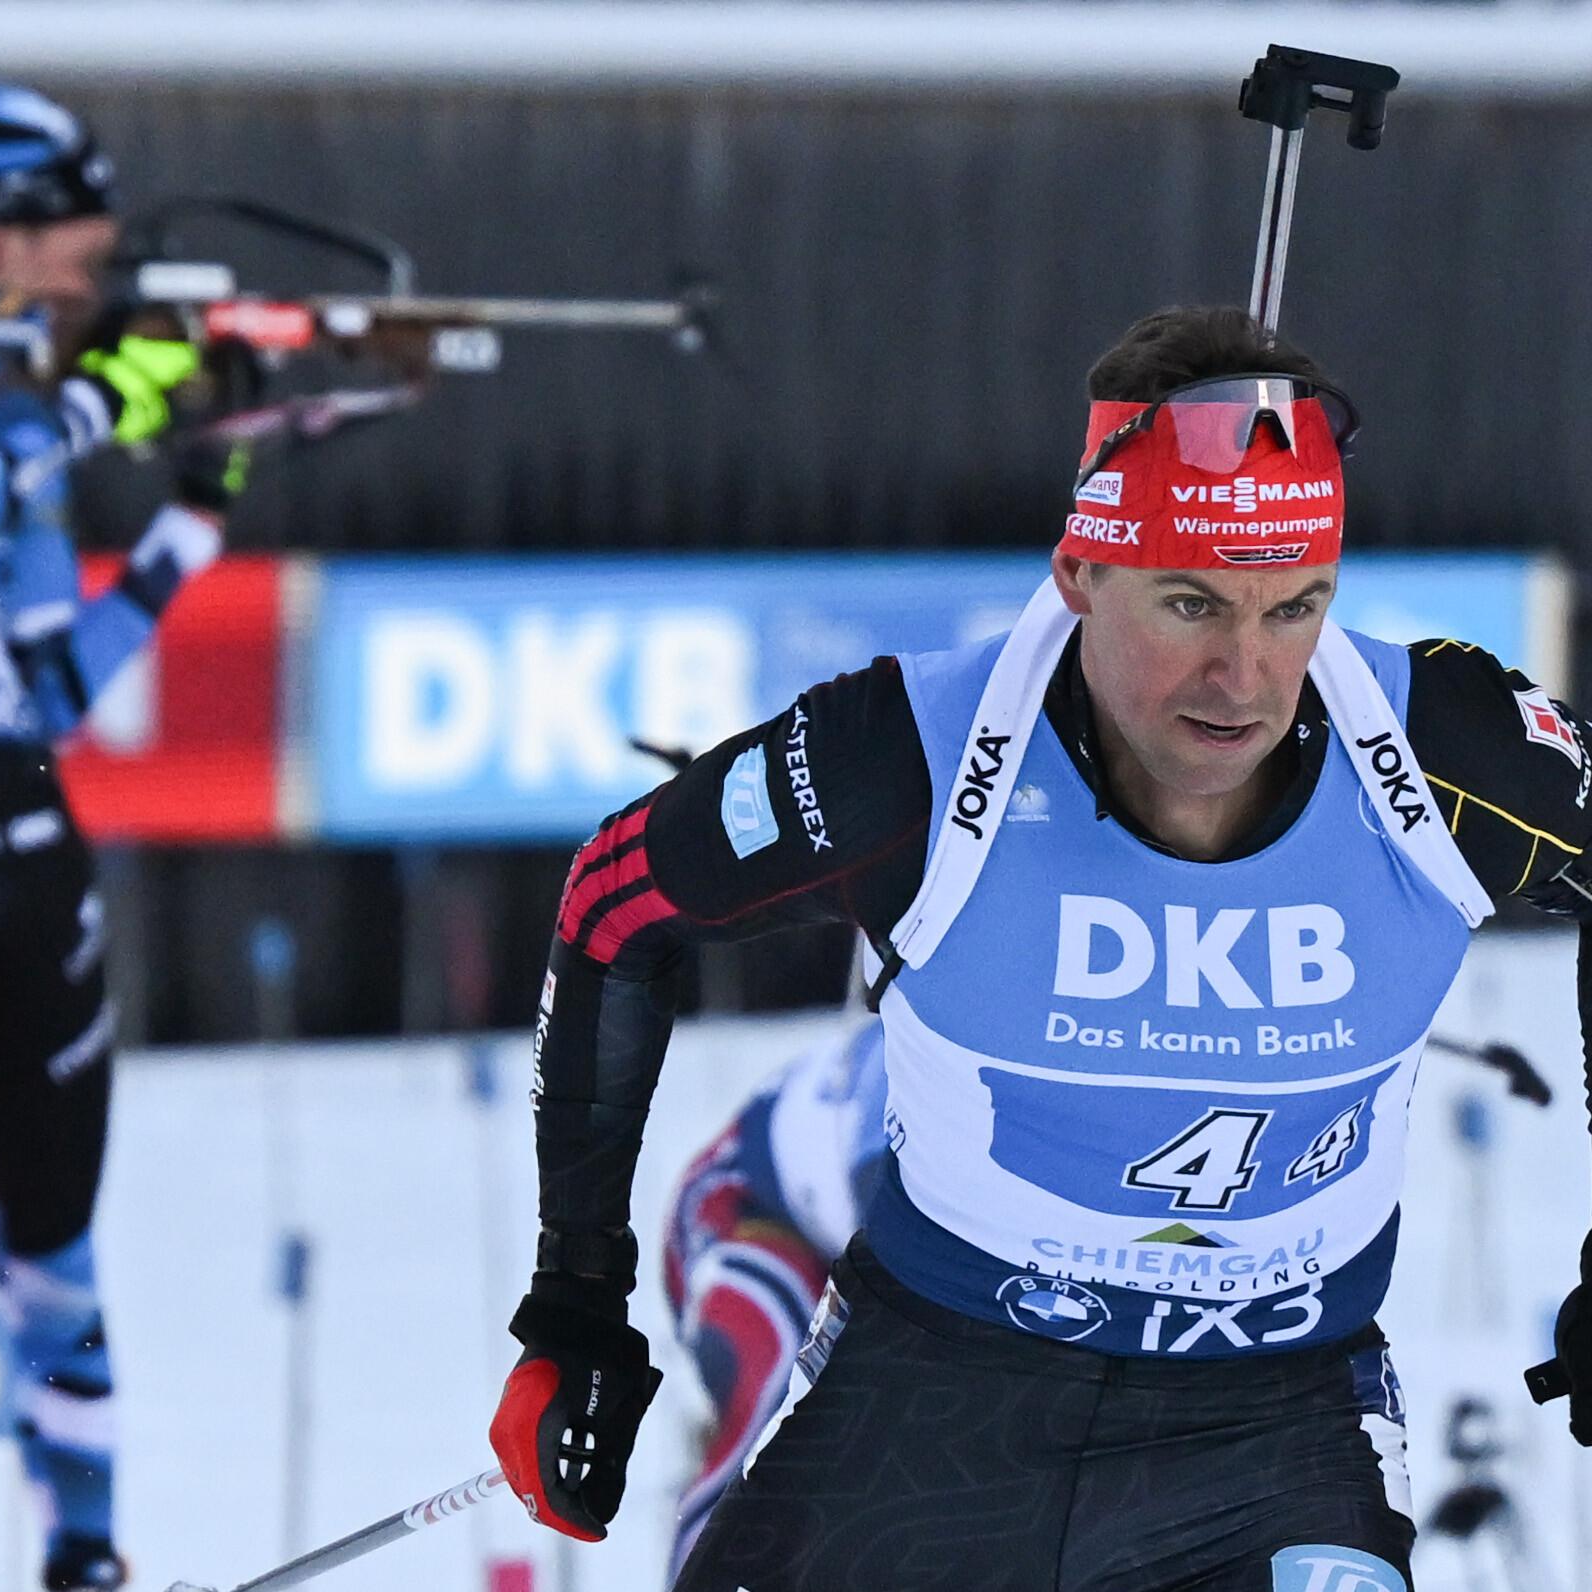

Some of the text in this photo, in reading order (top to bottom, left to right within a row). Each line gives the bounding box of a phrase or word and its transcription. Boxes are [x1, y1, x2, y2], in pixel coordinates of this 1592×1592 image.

[1171, 477, 1334, 513] VIESSMANN
[1173, 516, 1333, 538] Wärmepumpen
[365, 608, 758, 792] DKB
[787, 729, 833, 853] TERREX
[951, 732, 1012, 841] JOKA
[1356, 731, 1428, 834] JOKA
[1053, 893, 1356, 1009] DKB
[1045, 1011, 1356, 1056] Das kann Bank
[1121, 1096, 1368, 1213] 4 4
[1031, 1227, 1324, 1277] CHIEMGAU
